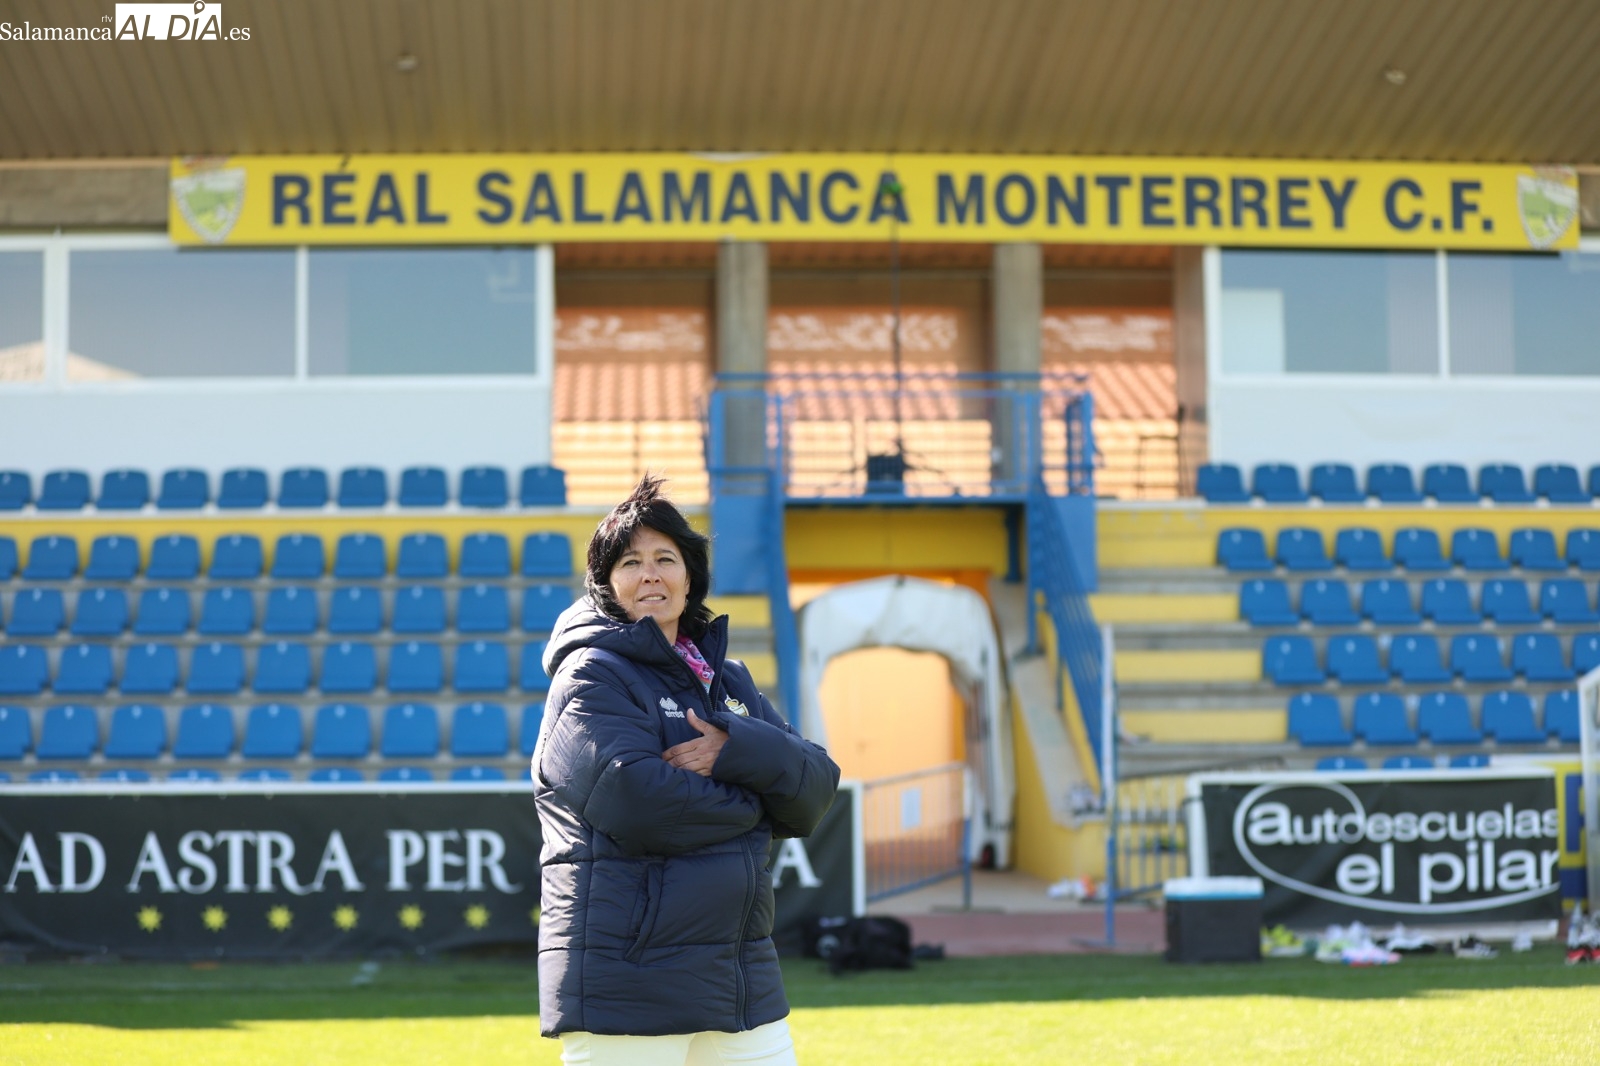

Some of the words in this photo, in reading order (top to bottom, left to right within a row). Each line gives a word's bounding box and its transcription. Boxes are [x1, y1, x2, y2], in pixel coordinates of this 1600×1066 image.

[476, 170, 910, 225] SALAMANCA
[936, 173, 1357, 229] MONTERREY
[1384, 179, 1494, 232] C.F.
[1246, 801, 1558, 846] autoescuelas
[4, 831, 107, 893] AD
[126, 829, 365, 896] ASTRA
[386, 829, 523, 894] PER
[1335, 842, 1395, 895] el
[1419, 841, 1559, 903] pilar
